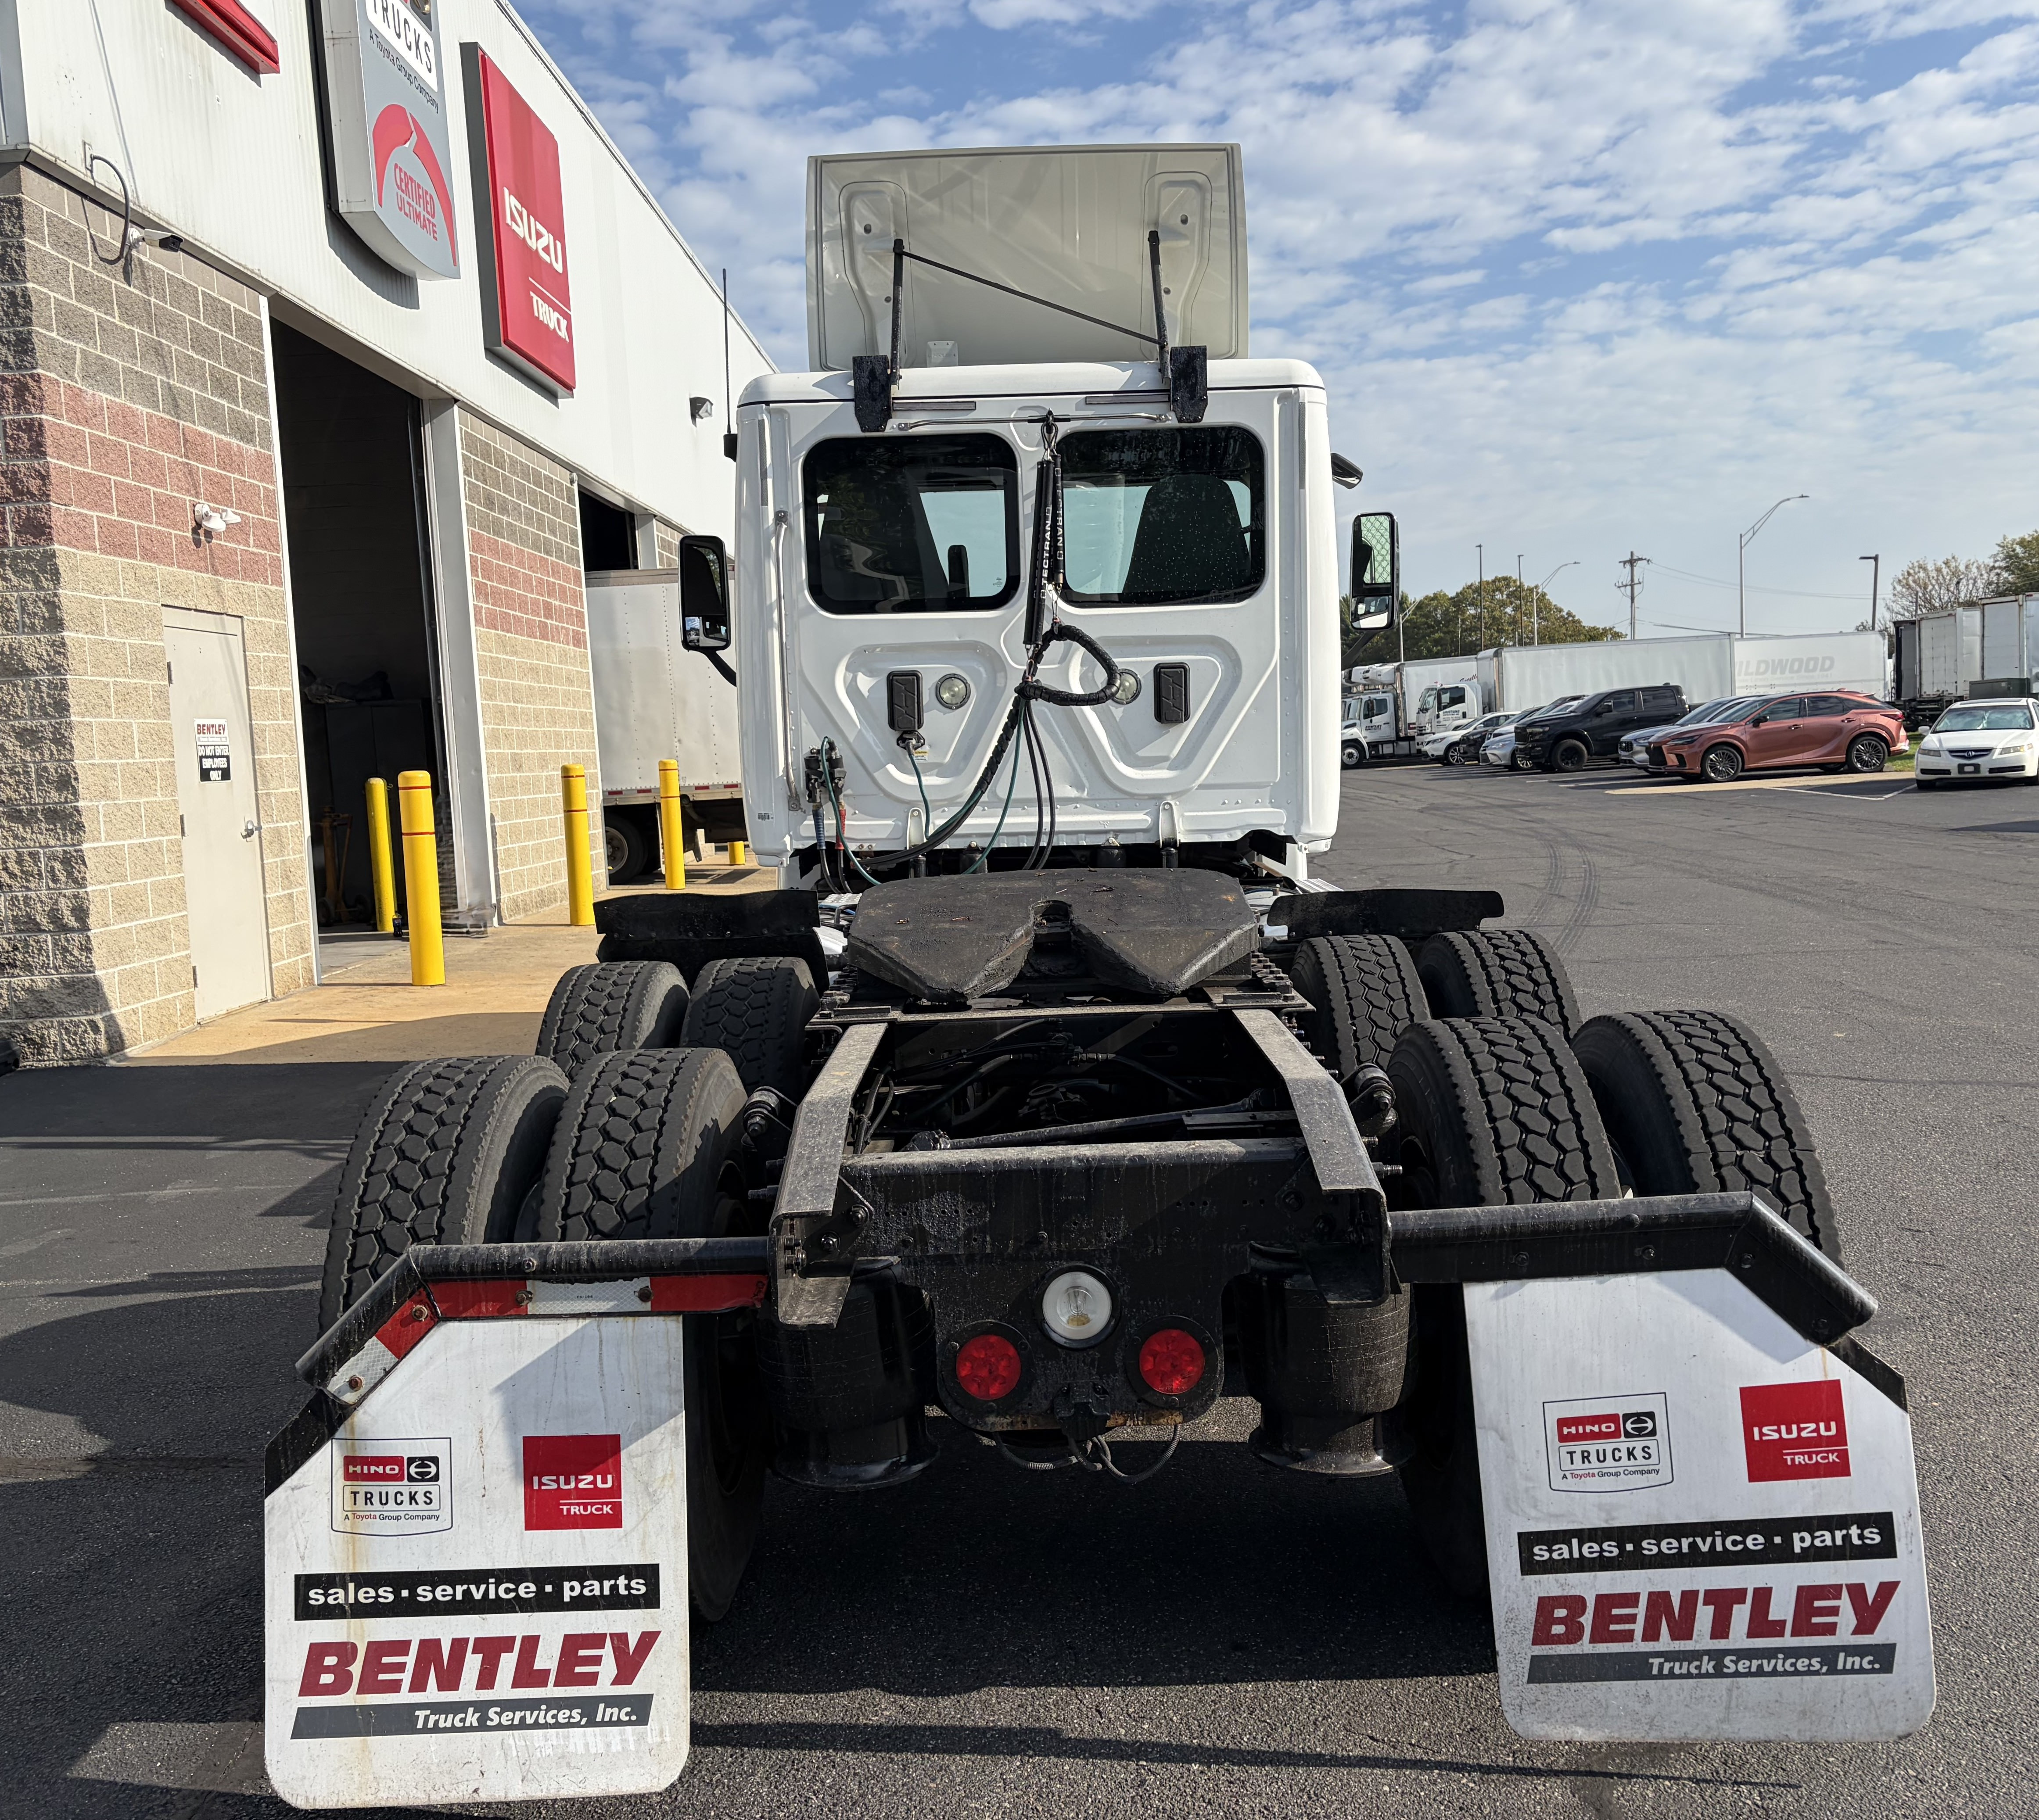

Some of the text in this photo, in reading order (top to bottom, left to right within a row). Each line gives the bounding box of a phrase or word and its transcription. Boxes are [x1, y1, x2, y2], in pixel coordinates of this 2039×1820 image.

[370, 29, 438, 114] A Toyota Group Company
[394, 163, 435, 219] CERTIFIED
[396, 192, 438, 241] ULTIMATE
[503, 186, 563, 274] ISUZU
[530, 291, 569, 343] TRUCK
[1042, 522, 1051, 586] TECTRAN
[1736, 656, 1835, 677] ILDWOOD
[197, 724, 225, 734] BENTLEY
[198, 745, 229, 756] DO NOT ENTER
[202, 758, 227, 768] EMPLOYEES
[210, 770, 221, 780] ONLY
[1563, 1423, 1615, 1434] HINO
[1754, 1422, 1837, 1441] ISUZU
[1566, 1446, 1652, 1465] TRUCKS
[1783, 1453, 1840, 1465] TRUCK
[349, 1465, 399, 1474] HINO
[532, 1474, 612, 1490] ISUZU
[351, 1490, 433, 1506] TRUCKS
[560, 1505, 613, 1515] TRUCK
[1533, 1524, 1881, 1560] sales service parts
[308, 1574, 647, 1605] sales service parts
[1531, 1580, 1901, 1646] BENTLEY
[298, 1631, 662, 1697] BENTLEY
[1648, 1652, 1881, 1675] Truck Services, Inc.
[414, 1703, 637, 1730] Truck Services, Inc.
